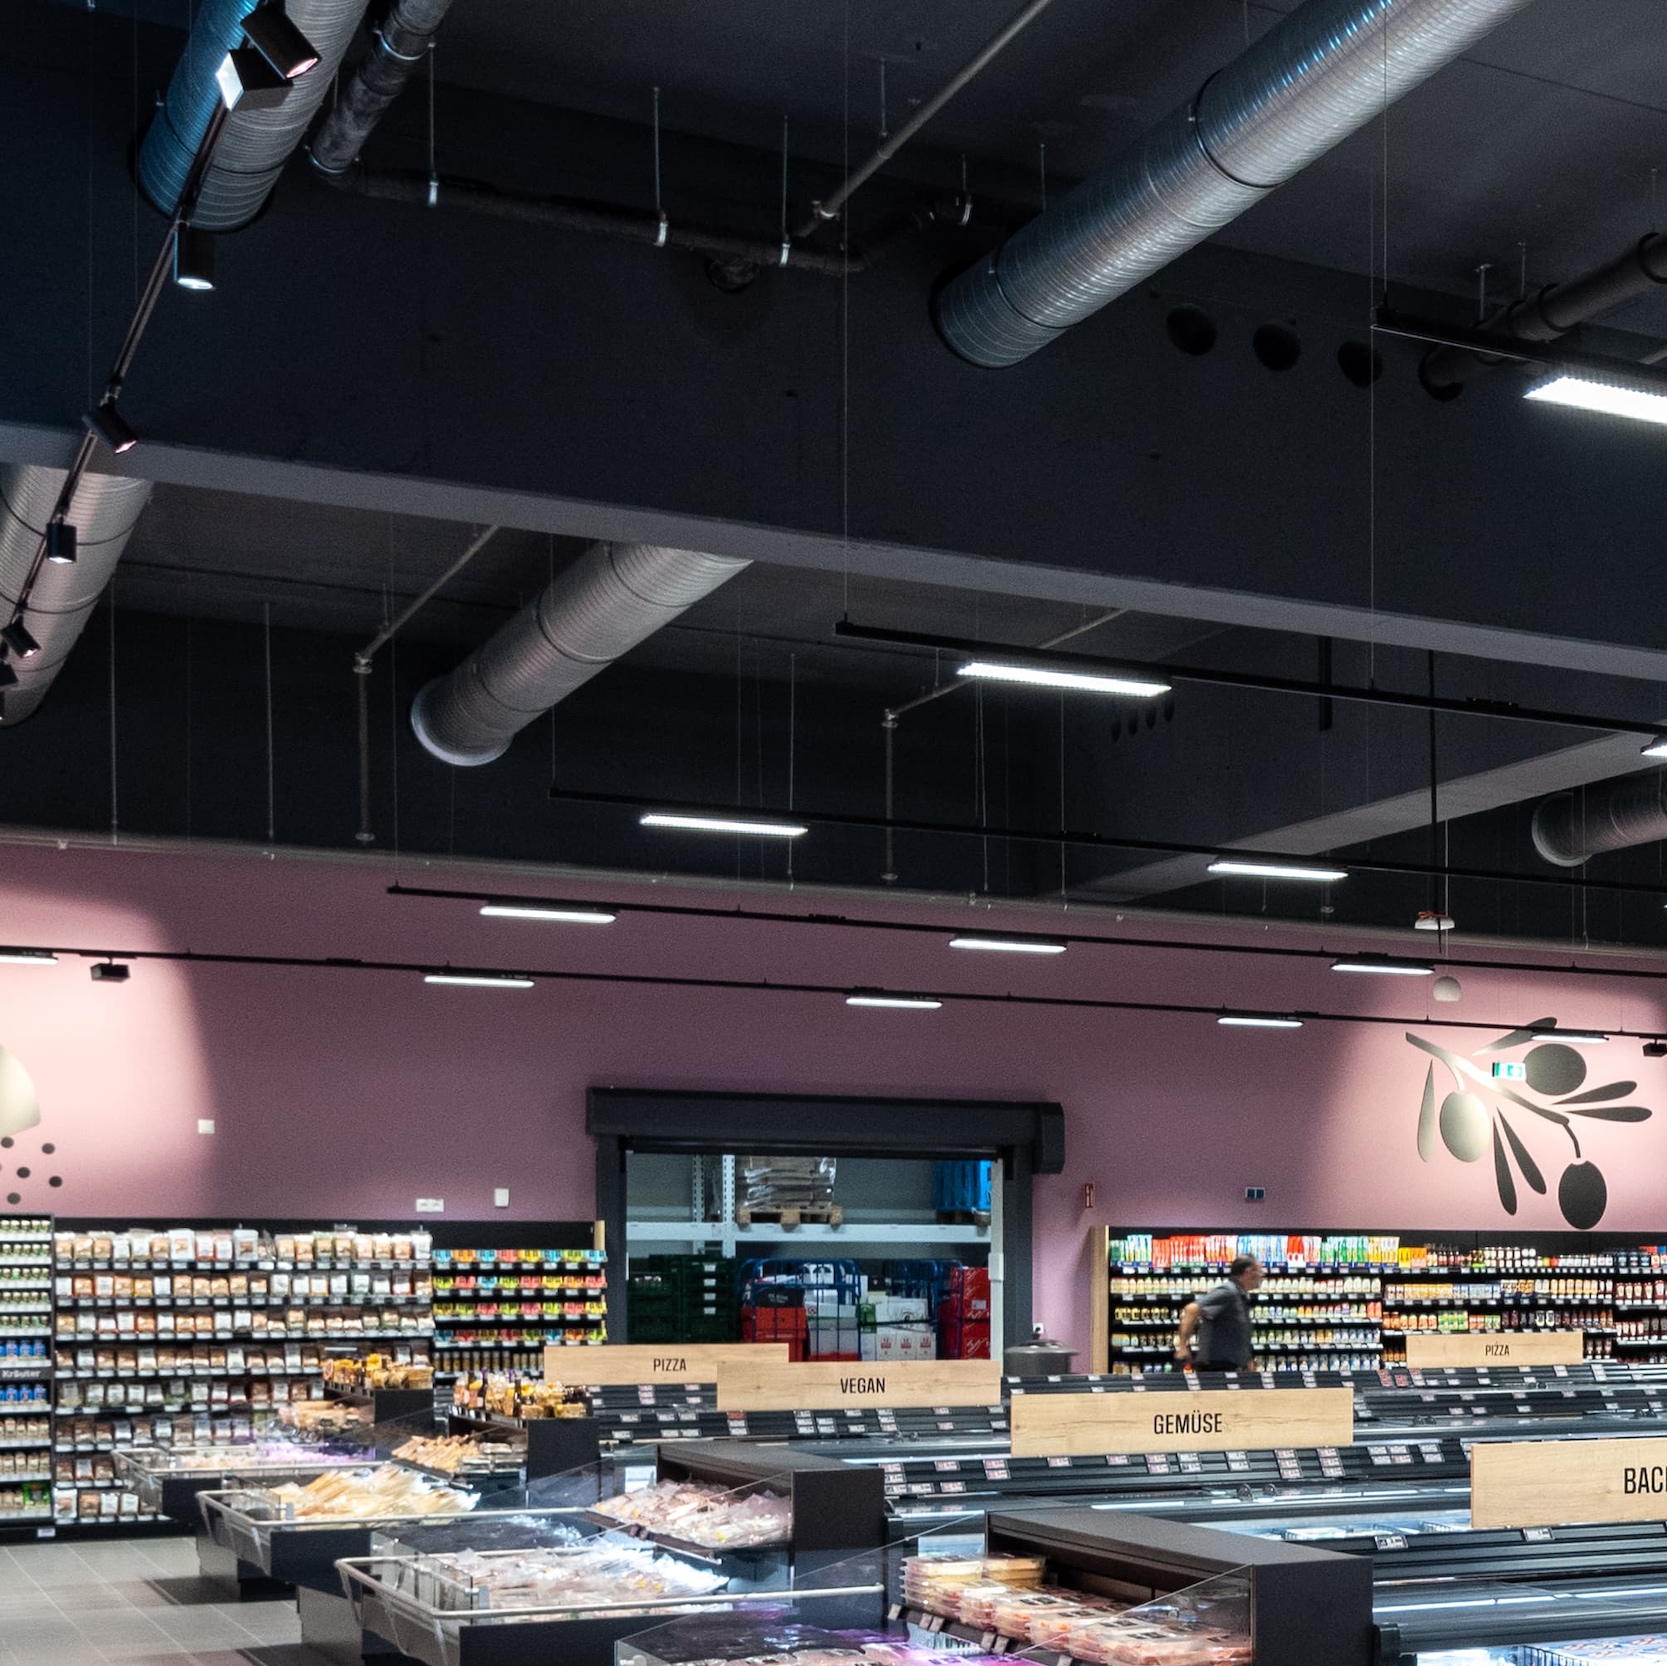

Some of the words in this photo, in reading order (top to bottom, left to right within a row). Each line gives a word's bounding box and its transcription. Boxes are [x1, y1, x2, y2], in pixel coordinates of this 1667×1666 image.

[1485, 1343, 1510, 1358] PIZZA
[653, 1357, 687, 1373] PIZZA
[839, 1377, 886, 1395] VEGAN
[1153, 1409, 1223, 1436] GEMÜSE
